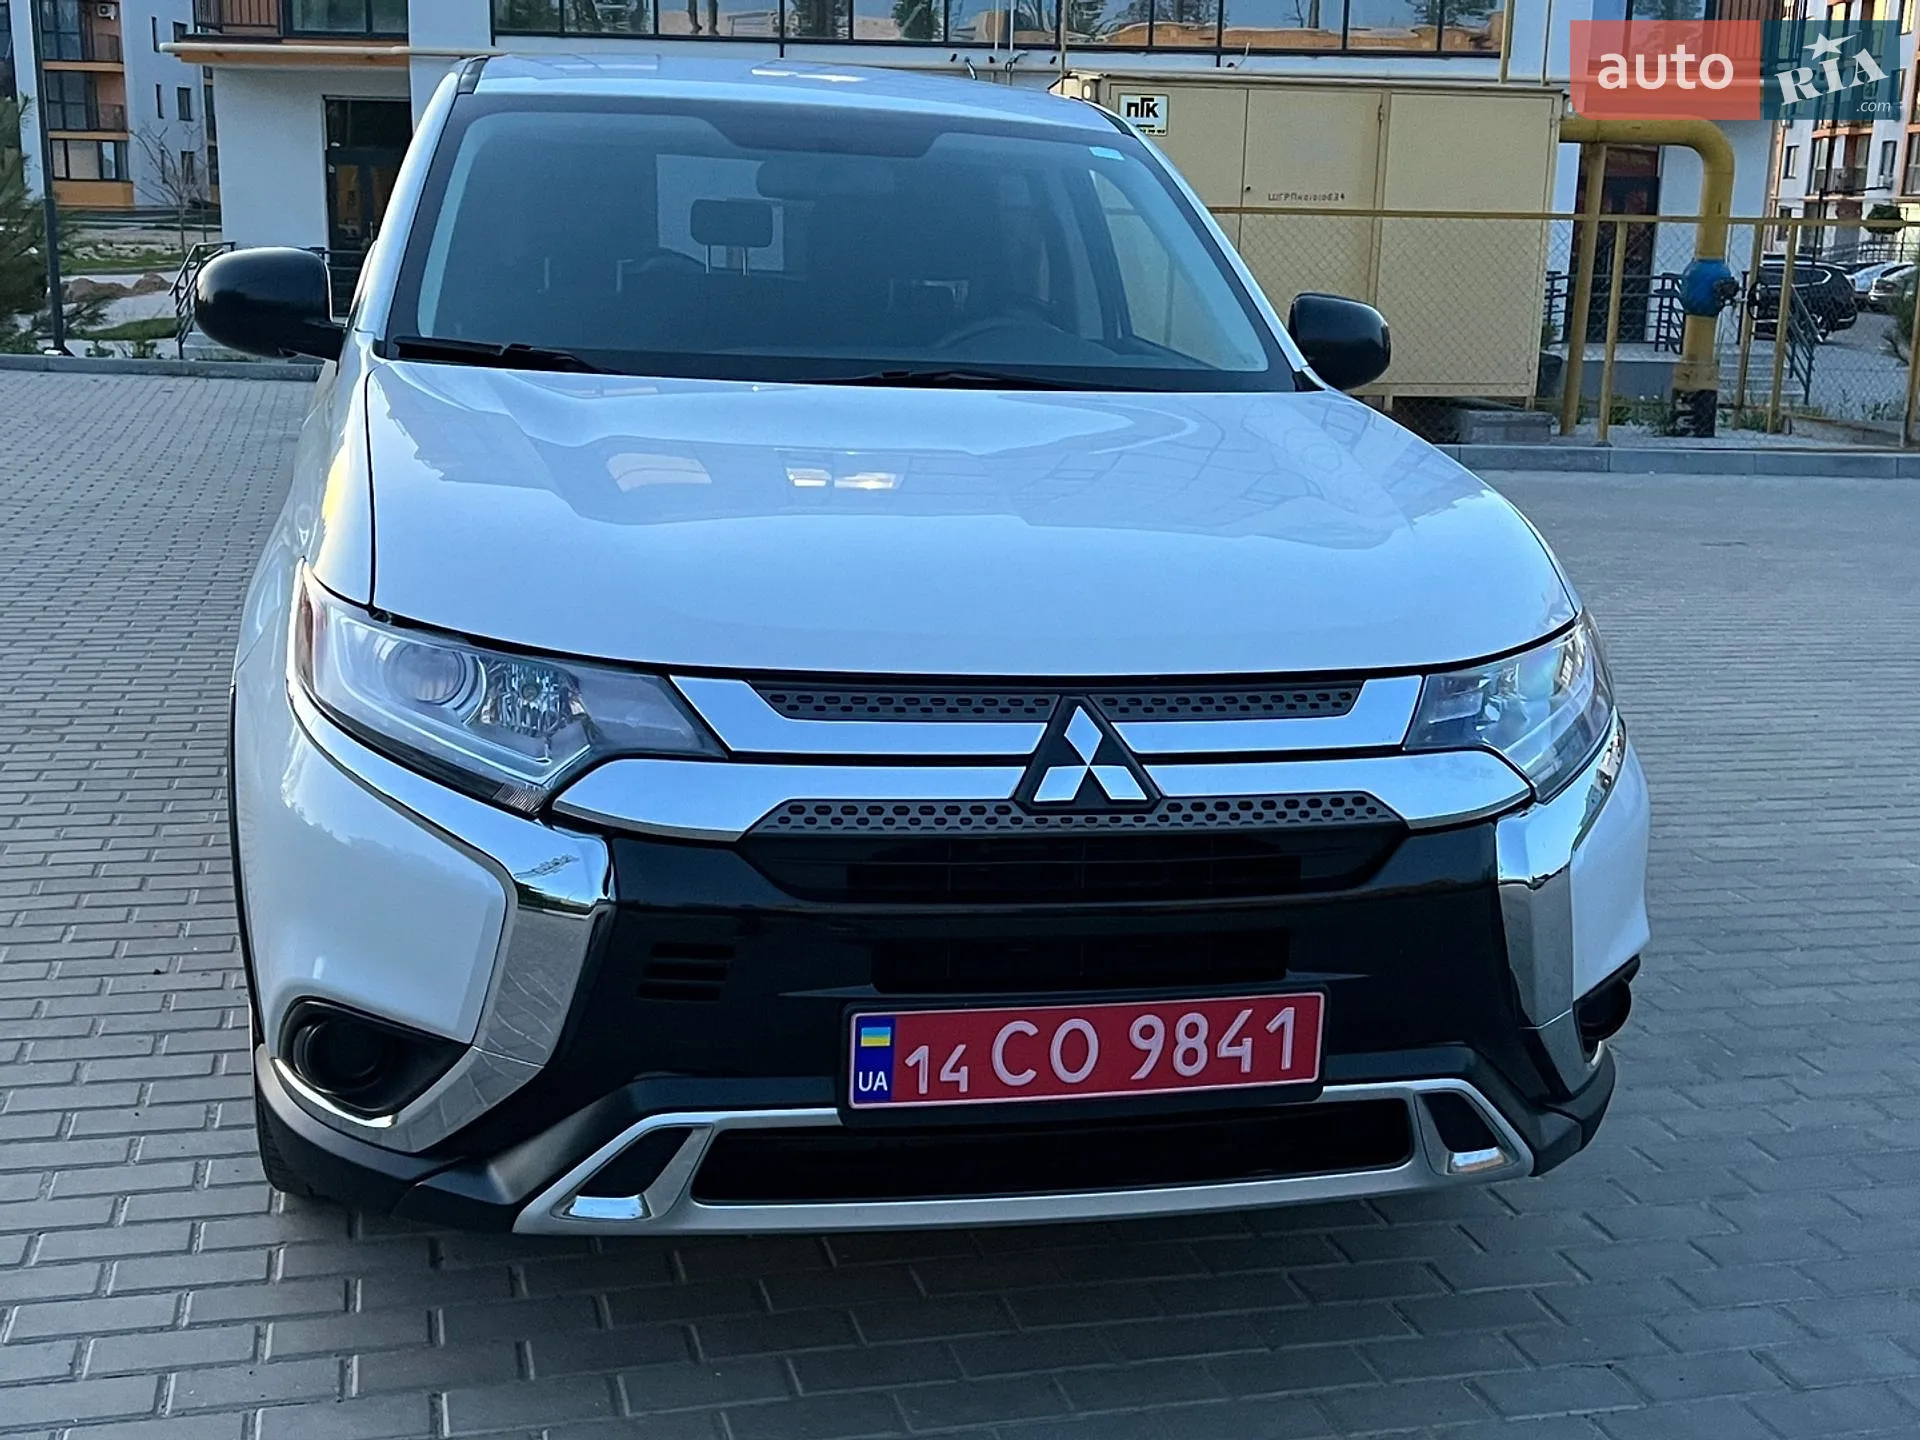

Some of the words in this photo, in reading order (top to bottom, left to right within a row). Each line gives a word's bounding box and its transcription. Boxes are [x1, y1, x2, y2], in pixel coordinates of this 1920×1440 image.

[905, 1044, 968, 1095] 14
[992, 1018, 1098, 1087] CO
[1129, 1006, 1295, 1080] 9841
[858, 1071, 888, 1093] UA
